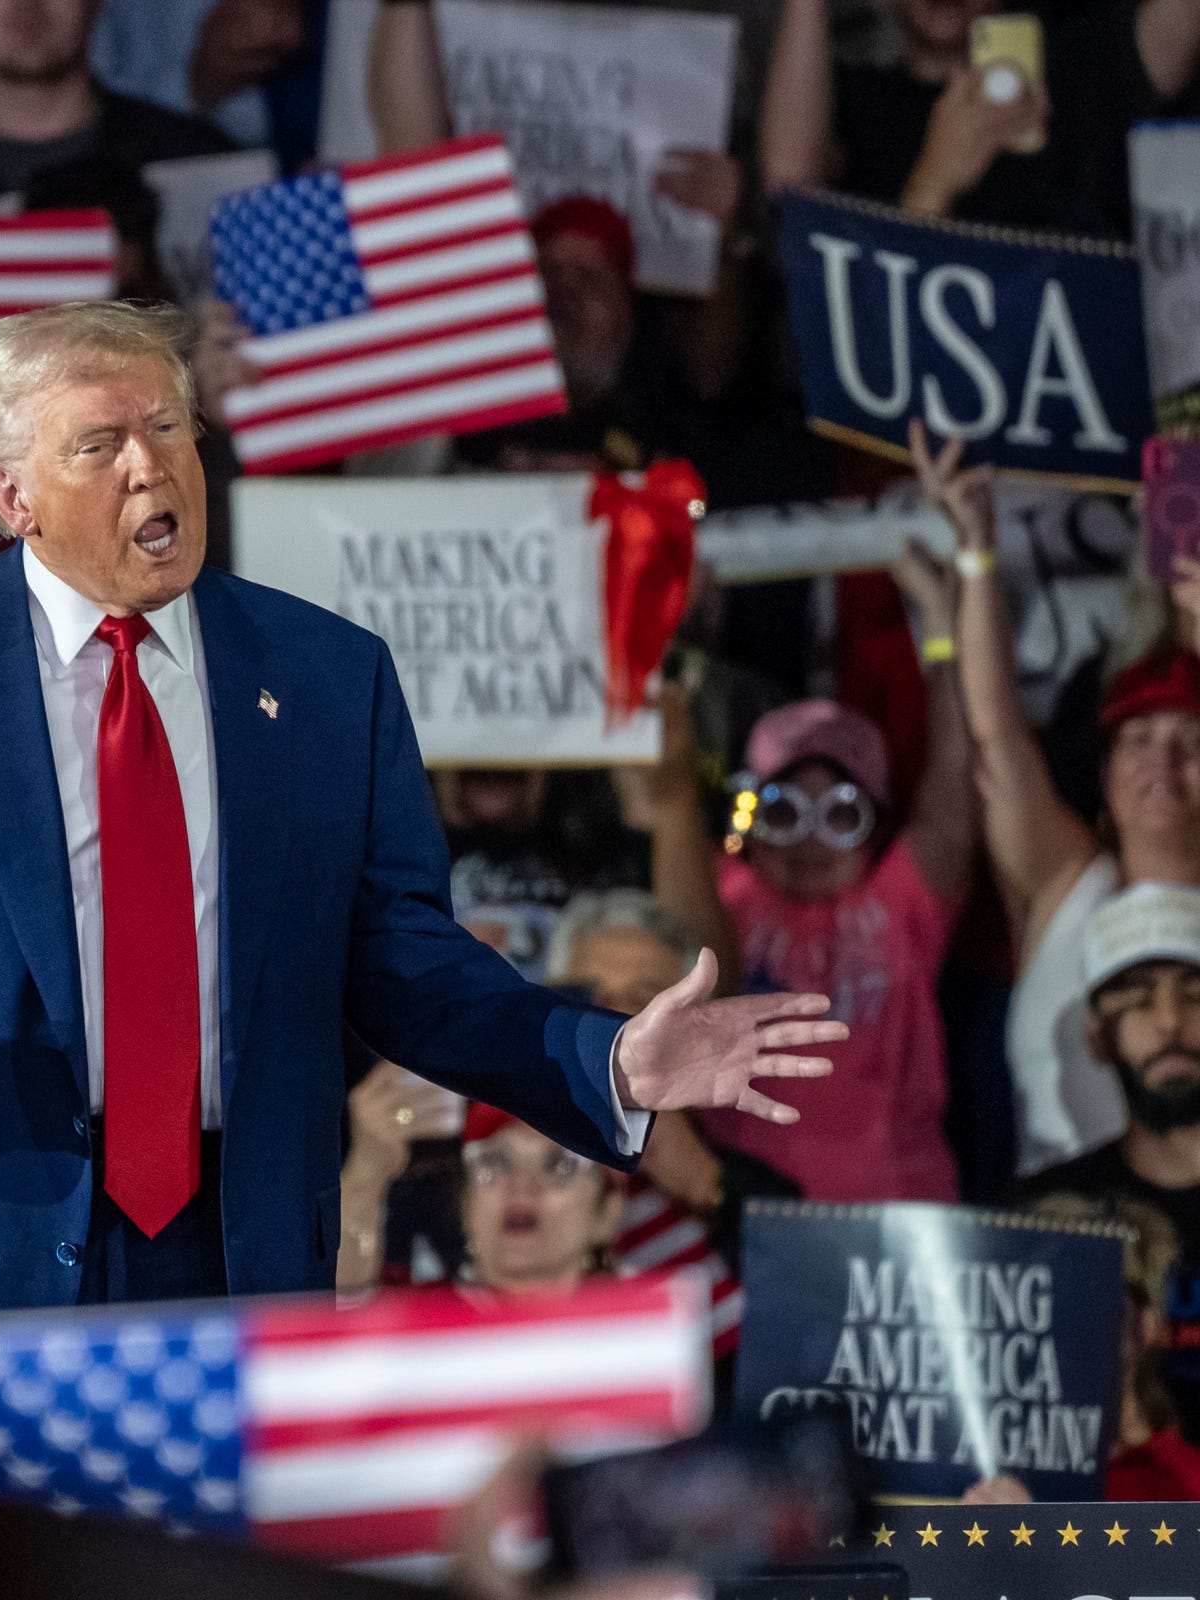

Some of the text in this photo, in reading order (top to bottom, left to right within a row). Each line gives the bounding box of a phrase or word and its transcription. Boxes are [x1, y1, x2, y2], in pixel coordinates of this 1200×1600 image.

[808, 232, 1128, 454] USA
[337, 527, 555, 590] MAKING
[336, 592, 574, 656] MERICA
[842, 1255, 1054, 1336] MAKING
[826, 1325, 1063, 1402] AMERICA
[952, 1399, 1102, 1476] AGAIN!
